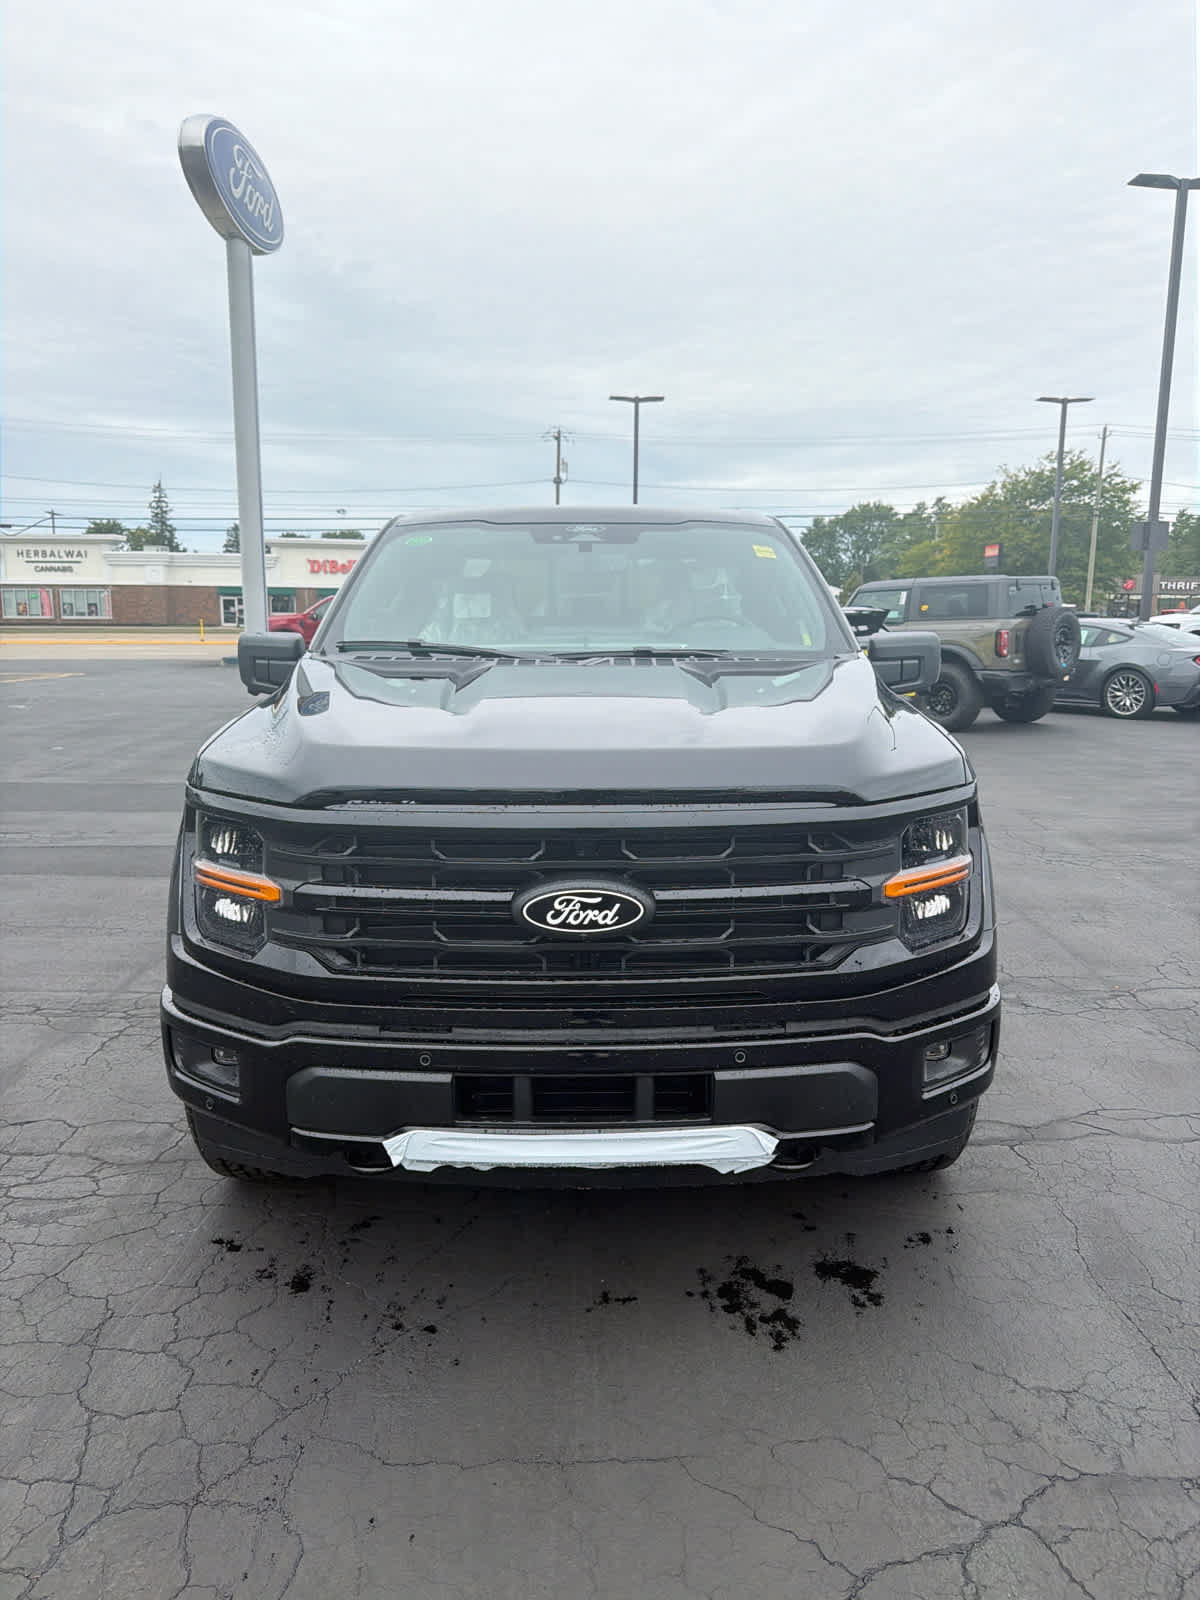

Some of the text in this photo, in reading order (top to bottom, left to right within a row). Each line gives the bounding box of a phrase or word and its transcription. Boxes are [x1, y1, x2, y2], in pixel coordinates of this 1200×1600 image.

[229, 144, 274, 232] Ford
[33, 565, 74, 573] CANNABIS
[306, 558, 357, 575] DiBel
[1160, 581, 1200, 590] THRIF
[546, 895, 621, 926] Ford
